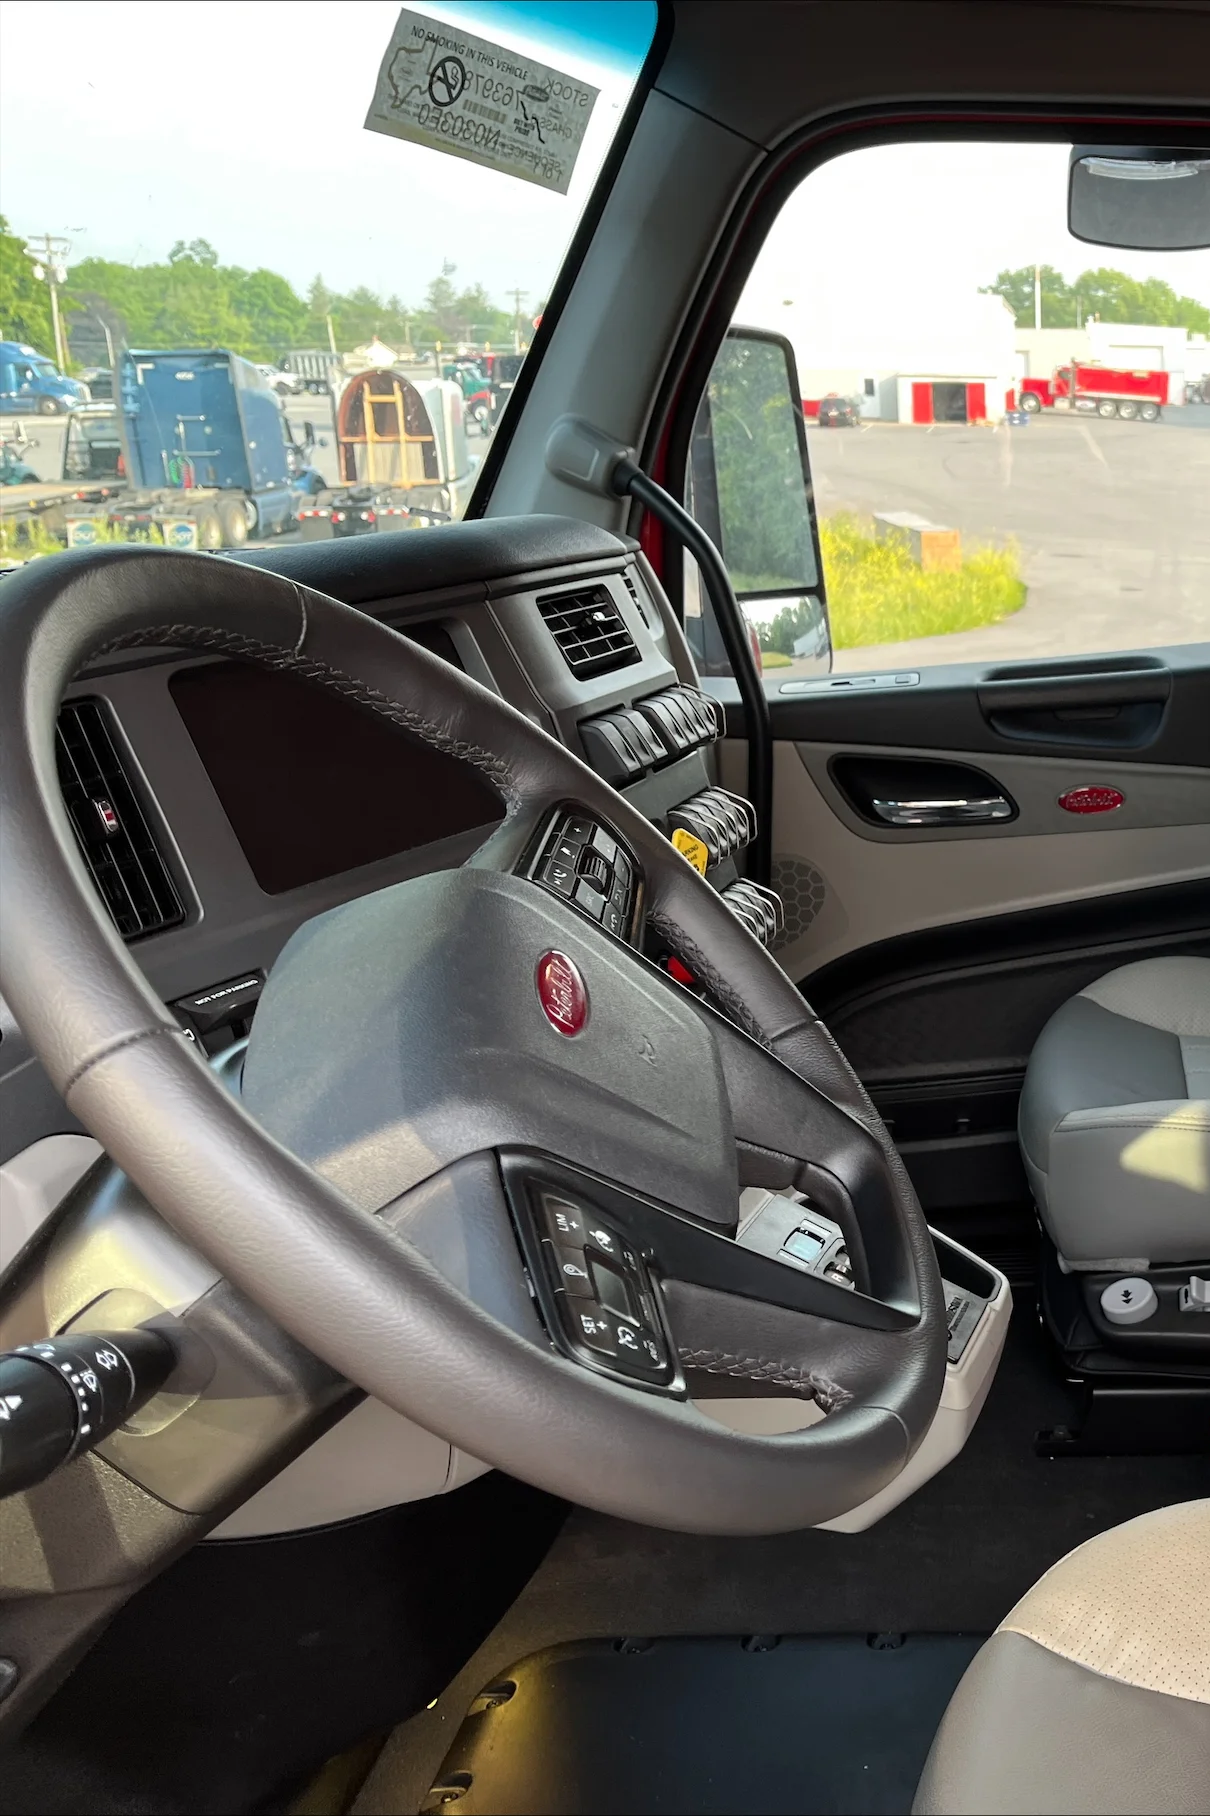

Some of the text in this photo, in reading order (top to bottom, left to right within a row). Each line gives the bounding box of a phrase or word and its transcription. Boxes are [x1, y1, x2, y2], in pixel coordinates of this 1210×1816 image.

[411, 25, 528, 81] NO SMOKING IN THIS VEHICLE
[194, 979, 259, 1005] NOT FOR PARKING
[546, 958, 575, 1028] Peterbilt
[555, 1213, 570, 1232] LIM
[580, 1314, 597, 1335] SET
